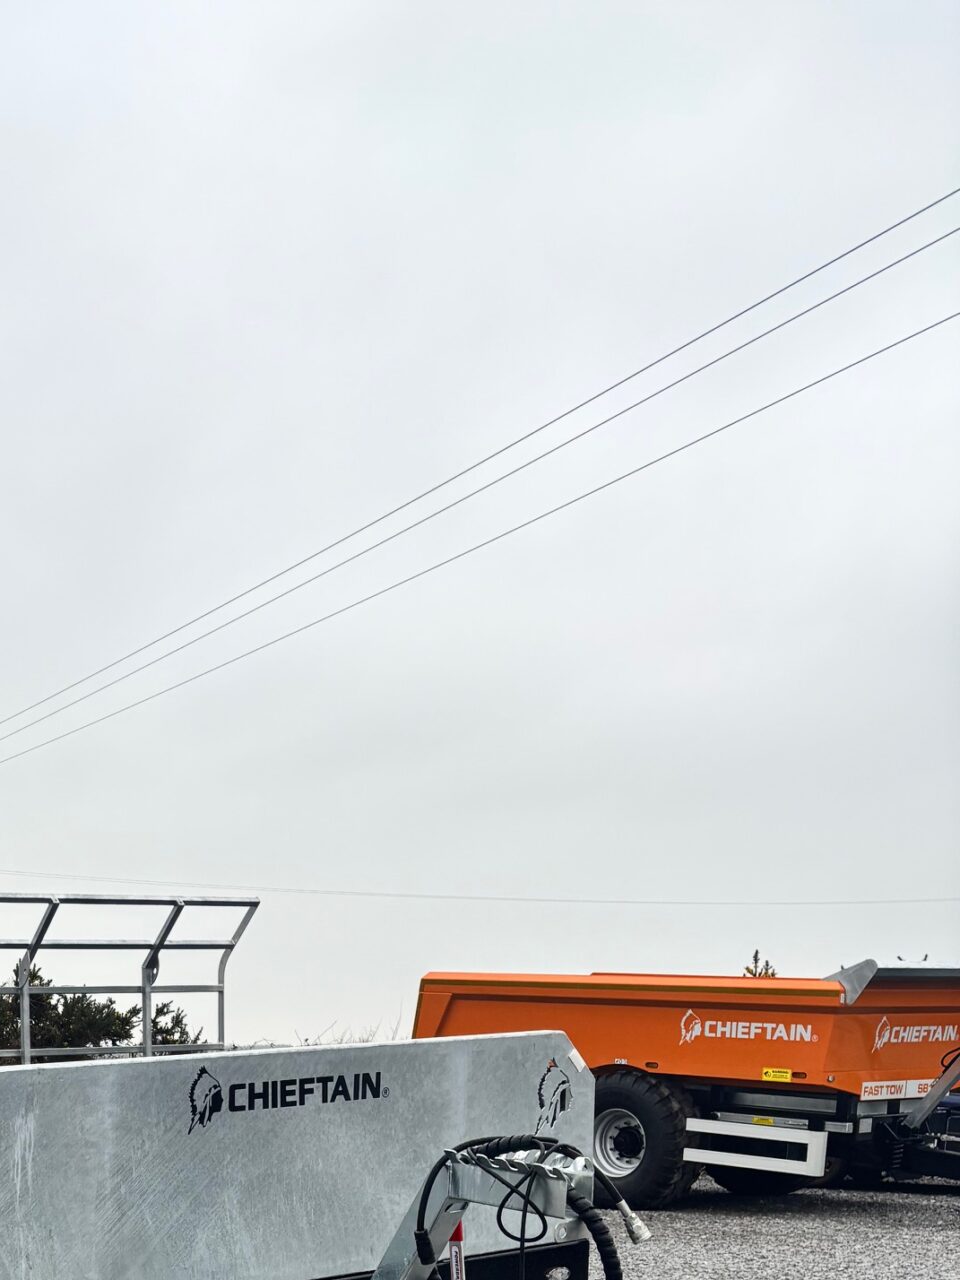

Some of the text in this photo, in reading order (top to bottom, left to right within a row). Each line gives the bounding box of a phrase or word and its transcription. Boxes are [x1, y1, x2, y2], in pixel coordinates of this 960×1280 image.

[704, 1020, 812, 1042] CHIEFTAIN
[889, 1025, 958, 1043] CHIEFTAIN
[228, 1071, 382, 1112] CHIEFTAIN
[863, 1084, 904, 1097] FAST TOW
